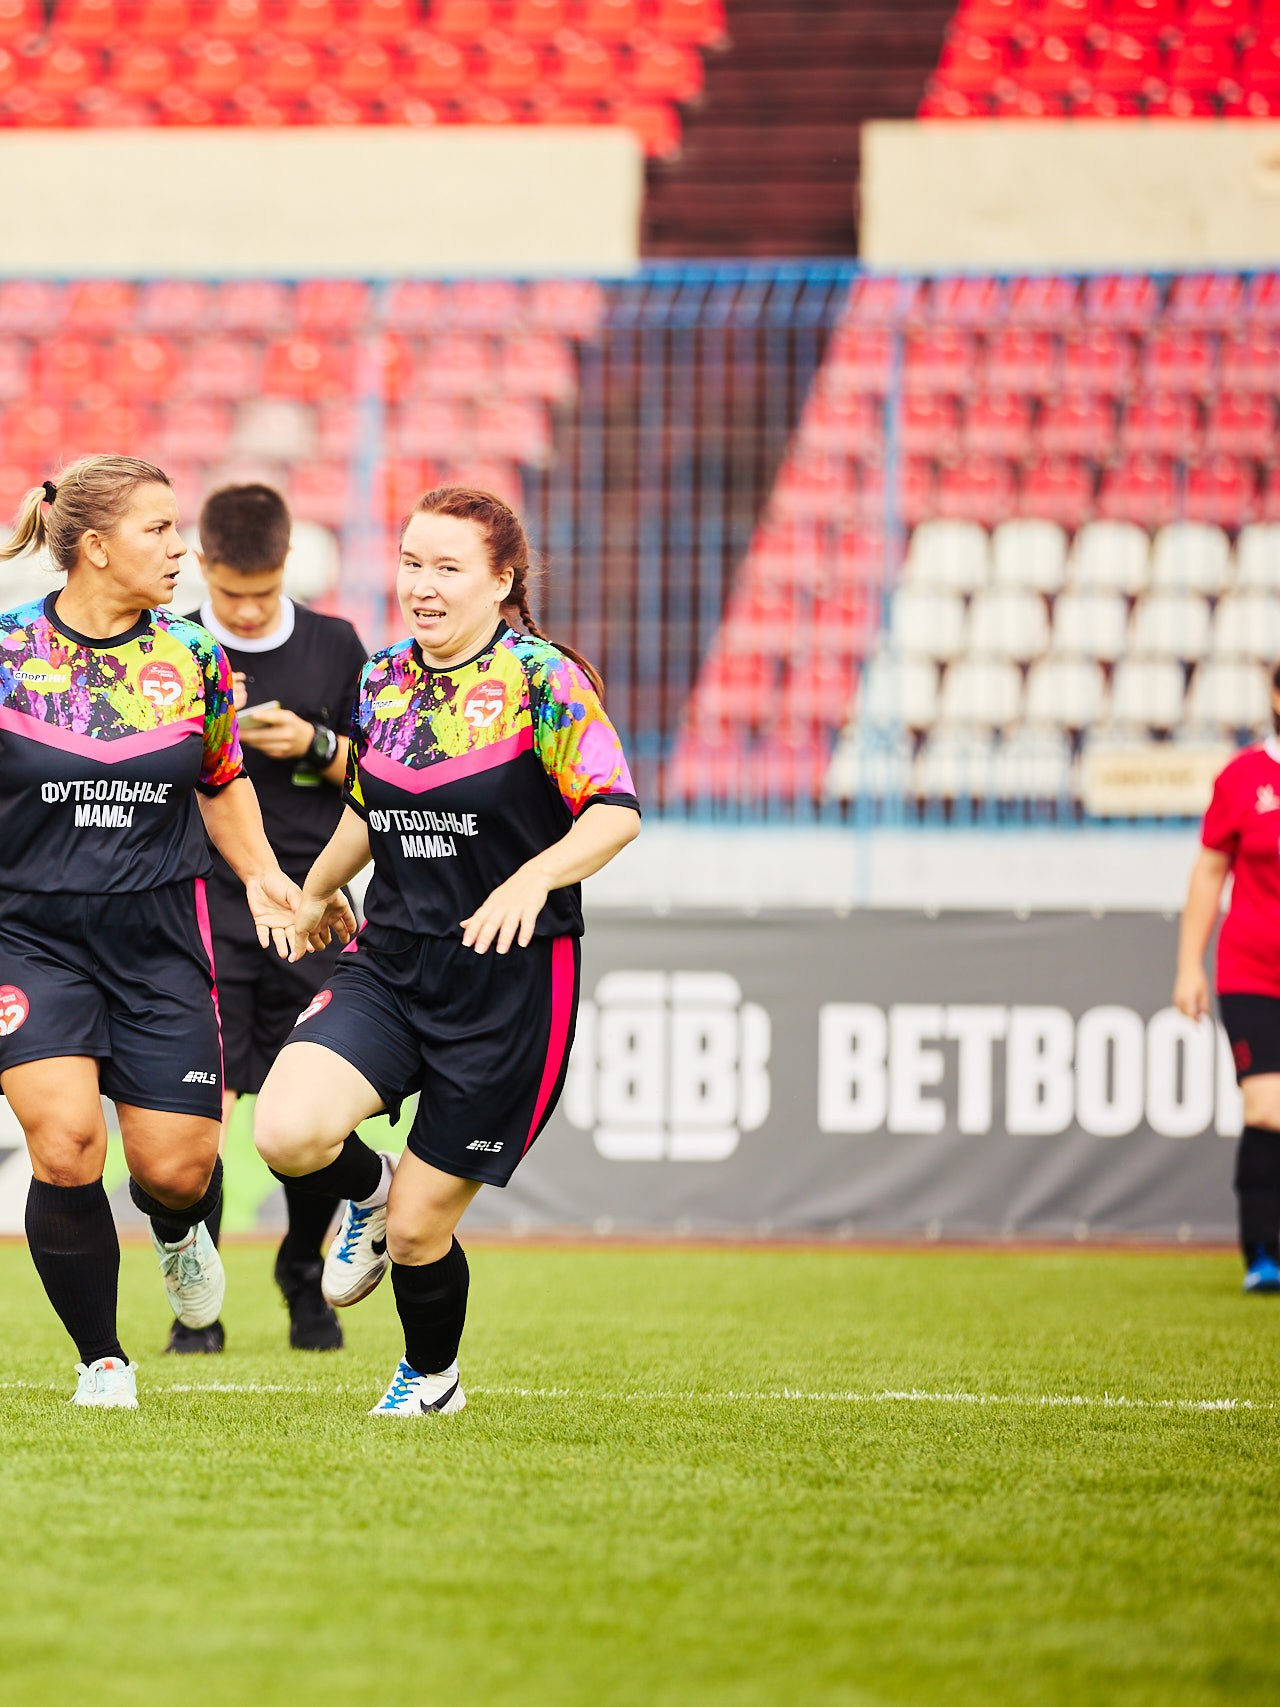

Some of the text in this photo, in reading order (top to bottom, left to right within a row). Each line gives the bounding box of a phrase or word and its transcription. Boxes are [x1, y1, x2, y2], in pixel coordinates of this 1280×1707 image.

[142, 680, 183, 706] 52
[464, 699, 504, 727] 52
[40, 779, 173, 804] ФУТБОЛЬНЫЕ
[74, 803, 135, 828] МАМЫ
[368, 809, 479, 836] ФУТБОЛЬНЫЕ
[400, 834, 458, 858] МАМЫ
